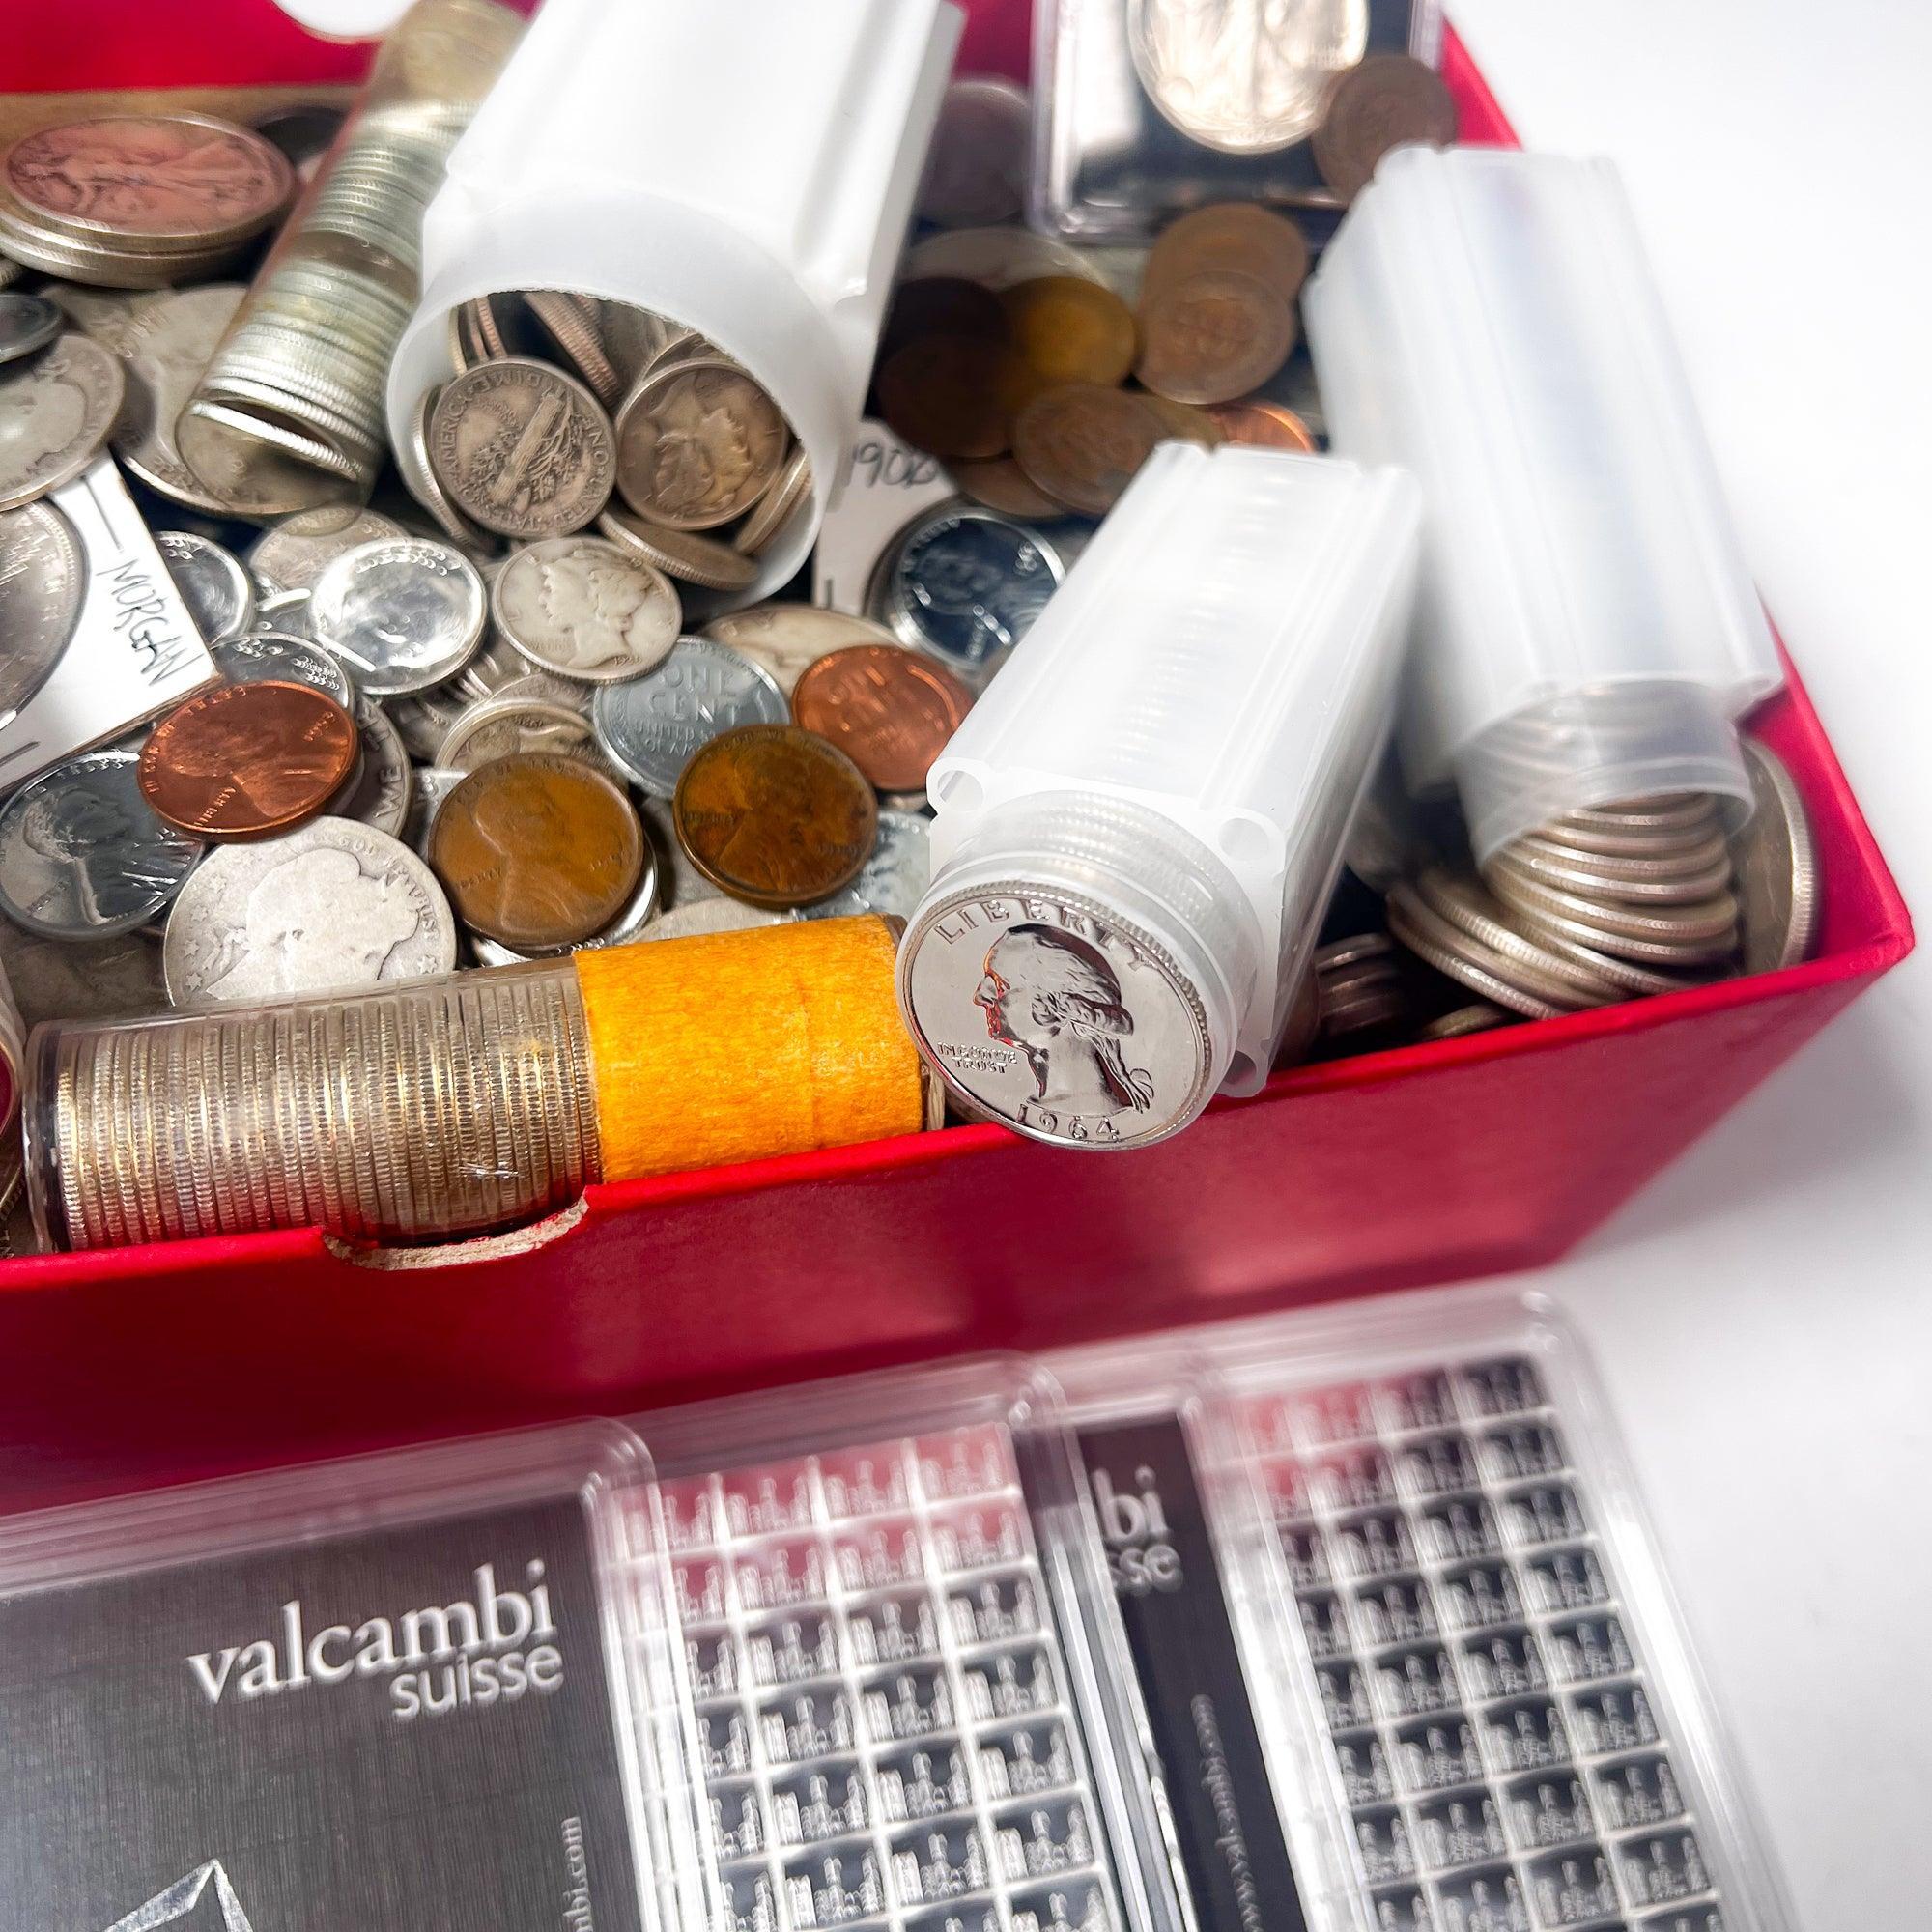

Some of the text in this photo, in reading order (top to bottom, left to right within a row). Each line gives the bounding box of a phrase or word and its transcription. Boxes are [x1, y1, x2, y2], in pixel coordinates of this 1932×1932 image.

[96, 558, 205, 687] MORGAN
[651, 692, 741, 726] CENT
[934, 897, 1159, 972] LIBERTY
[952, 1055, 1008, 1074] TRUST
[1016, 1102, 1120, 1144] 1964
[186, 1557, 558, 1706] valcambi
[389, 1645, 564, 1719] suisse
